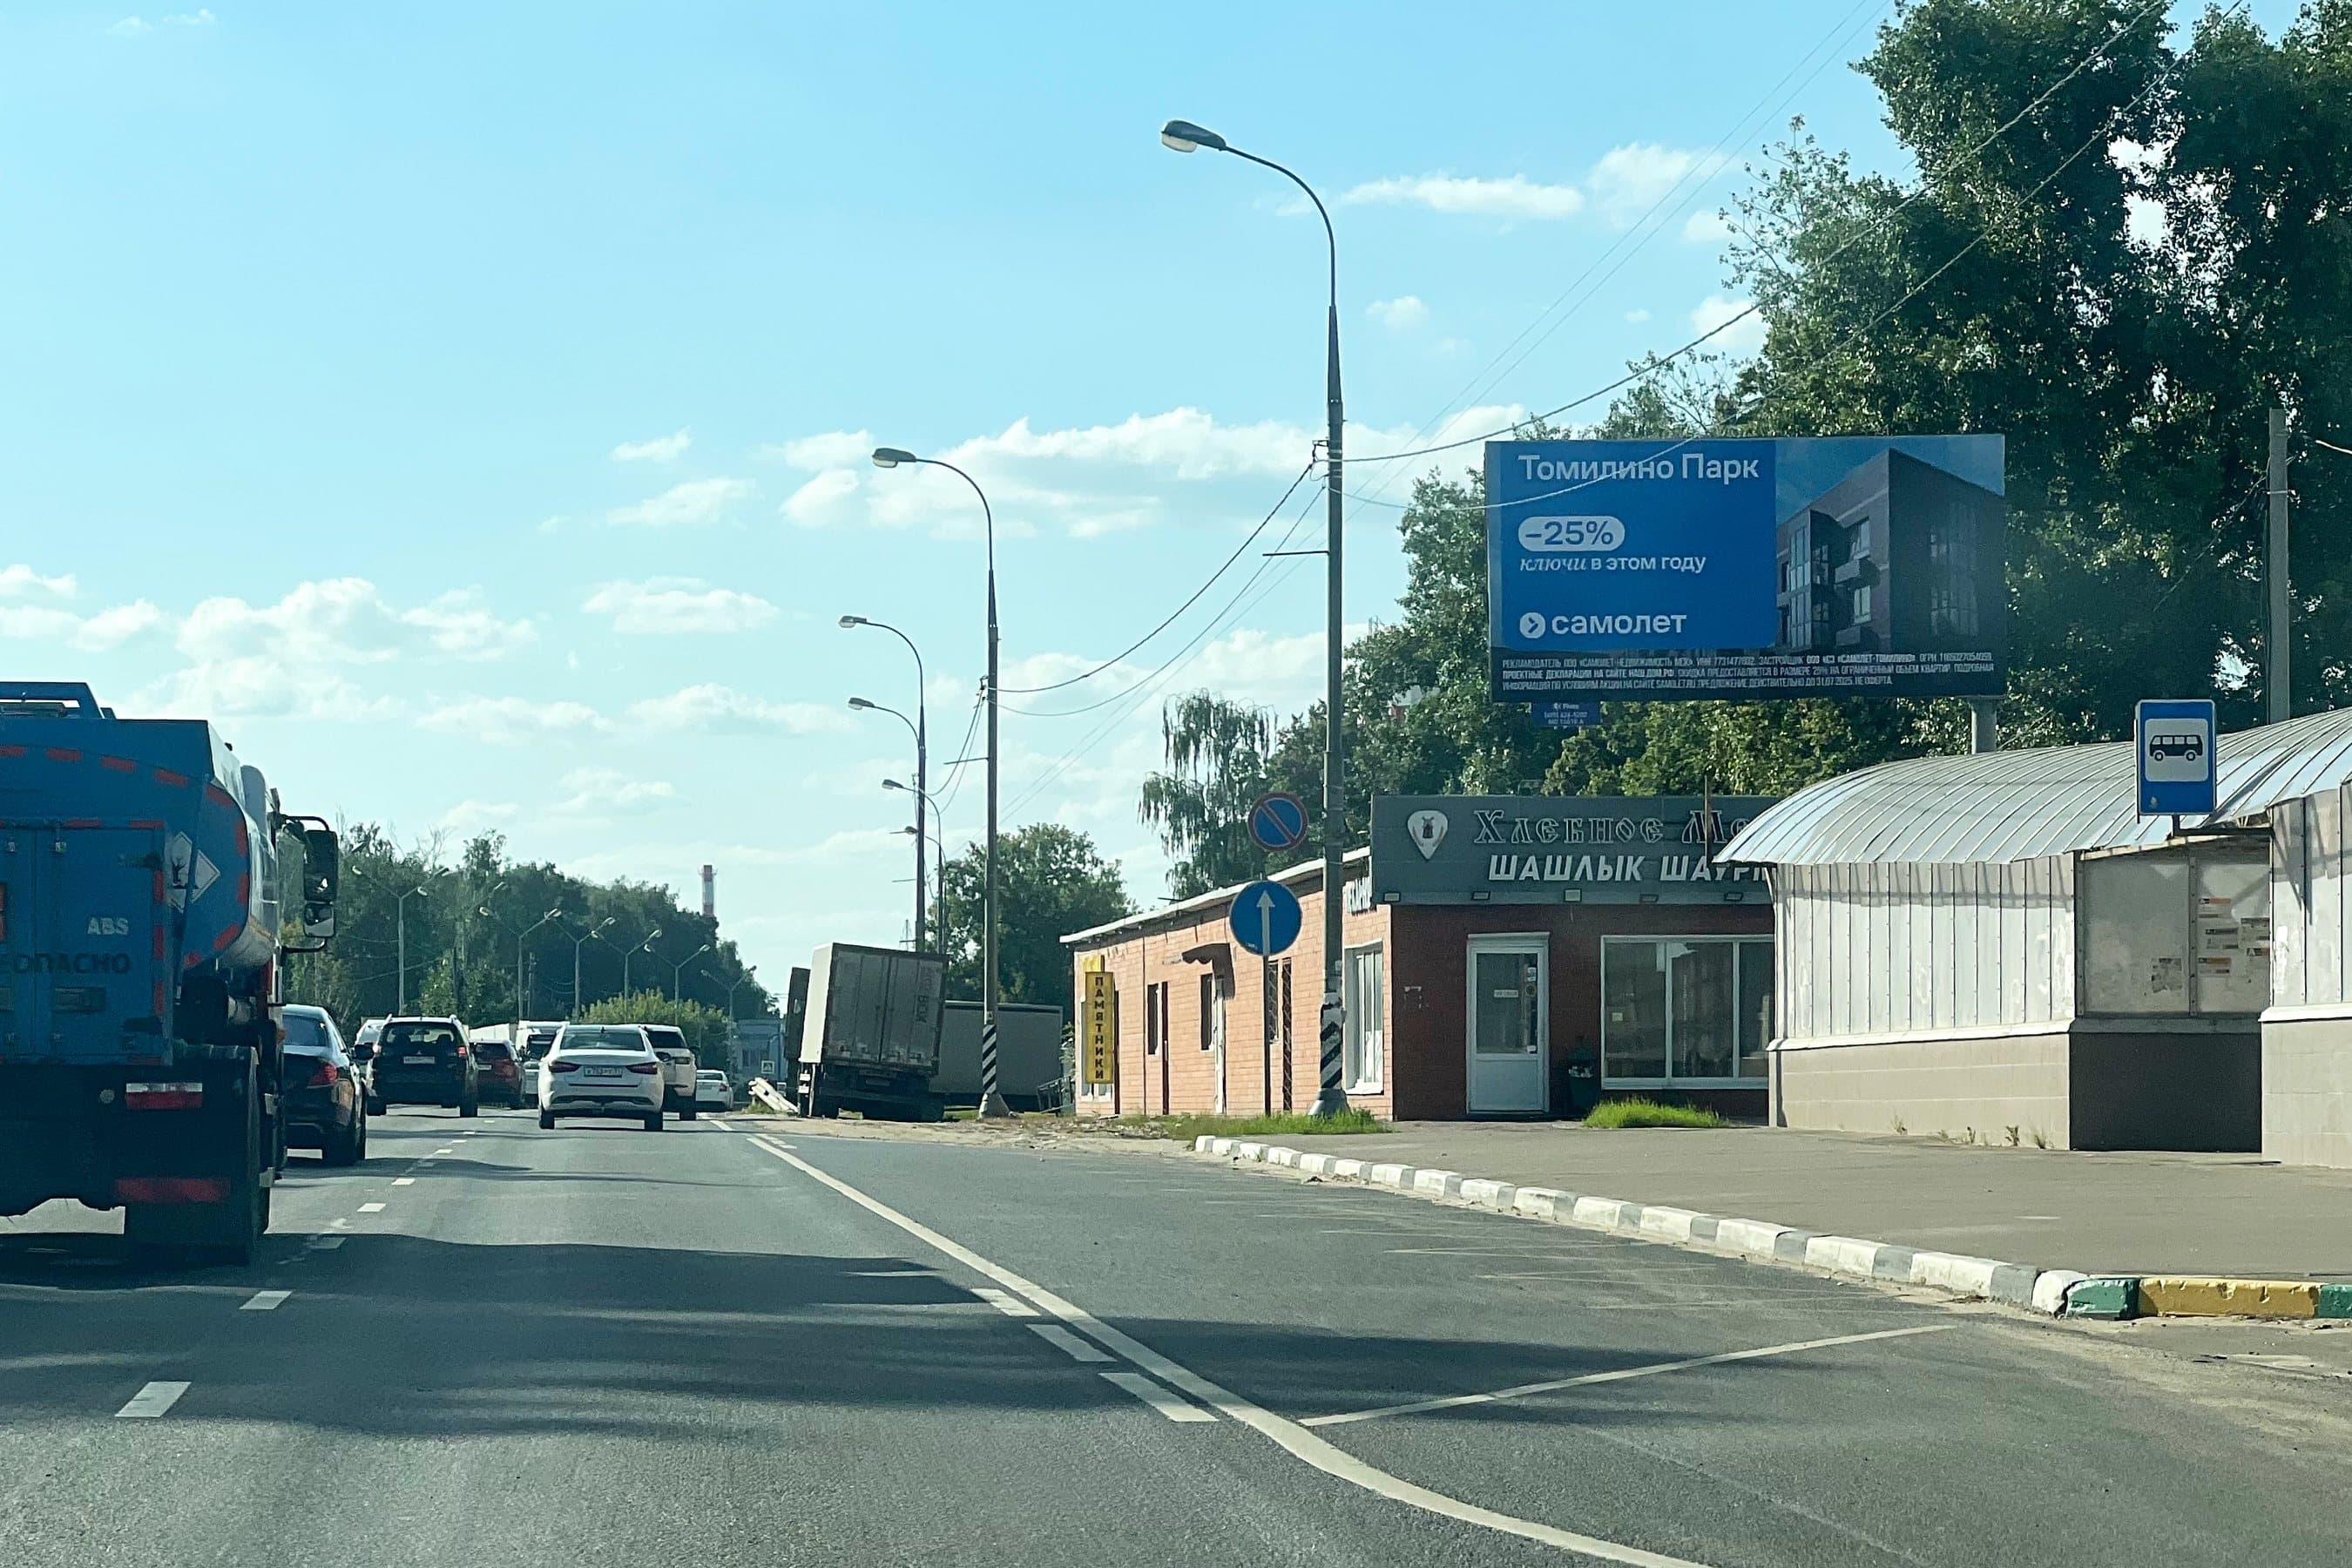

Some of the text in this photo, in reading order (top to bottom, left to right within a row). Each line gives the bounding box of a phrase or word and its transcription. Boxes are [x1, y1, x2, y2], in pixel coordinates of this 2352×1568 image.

[1518, 453, 1760, 484] Томилино Парк
[1519, 557, 1707, 573] ключи в этом году
[1551, 614, 1687, 634] самолет
[1488, 855, 1646, 882] ШАШЛЫК
[87, 916, 129, 935] ABS
[1094, 977, 1105, 1079] ПАМЯТНИКИ
